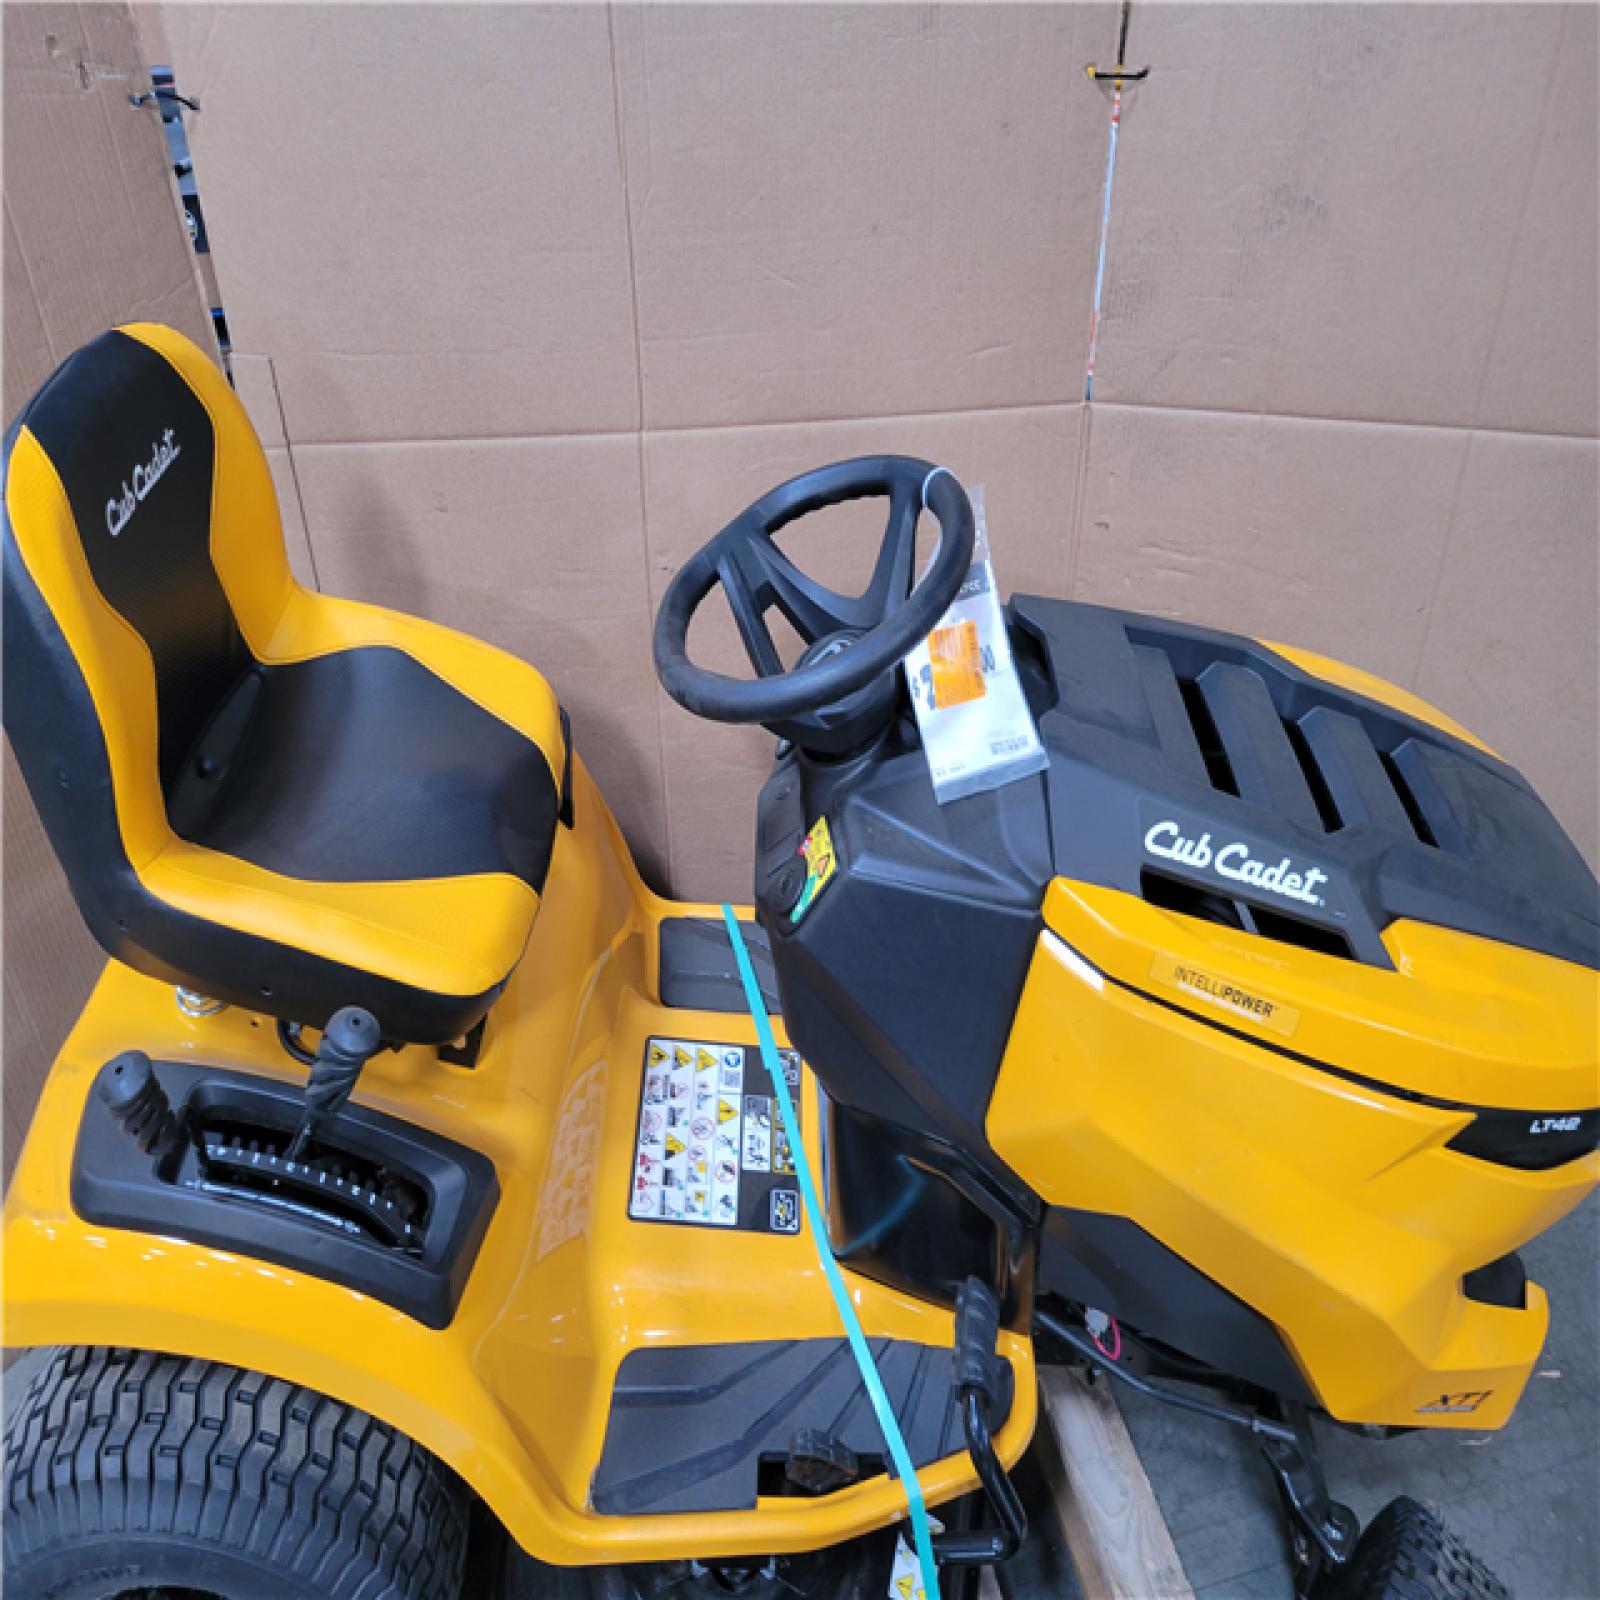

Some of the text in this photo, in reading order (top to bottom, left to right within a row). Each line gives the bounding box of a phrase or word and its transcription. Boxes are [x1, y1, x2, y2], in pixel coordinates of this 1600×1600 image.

[105, 428, 181, 537] Cub Cadet
[1145, 820, 1328, 906] Cub Cadet
